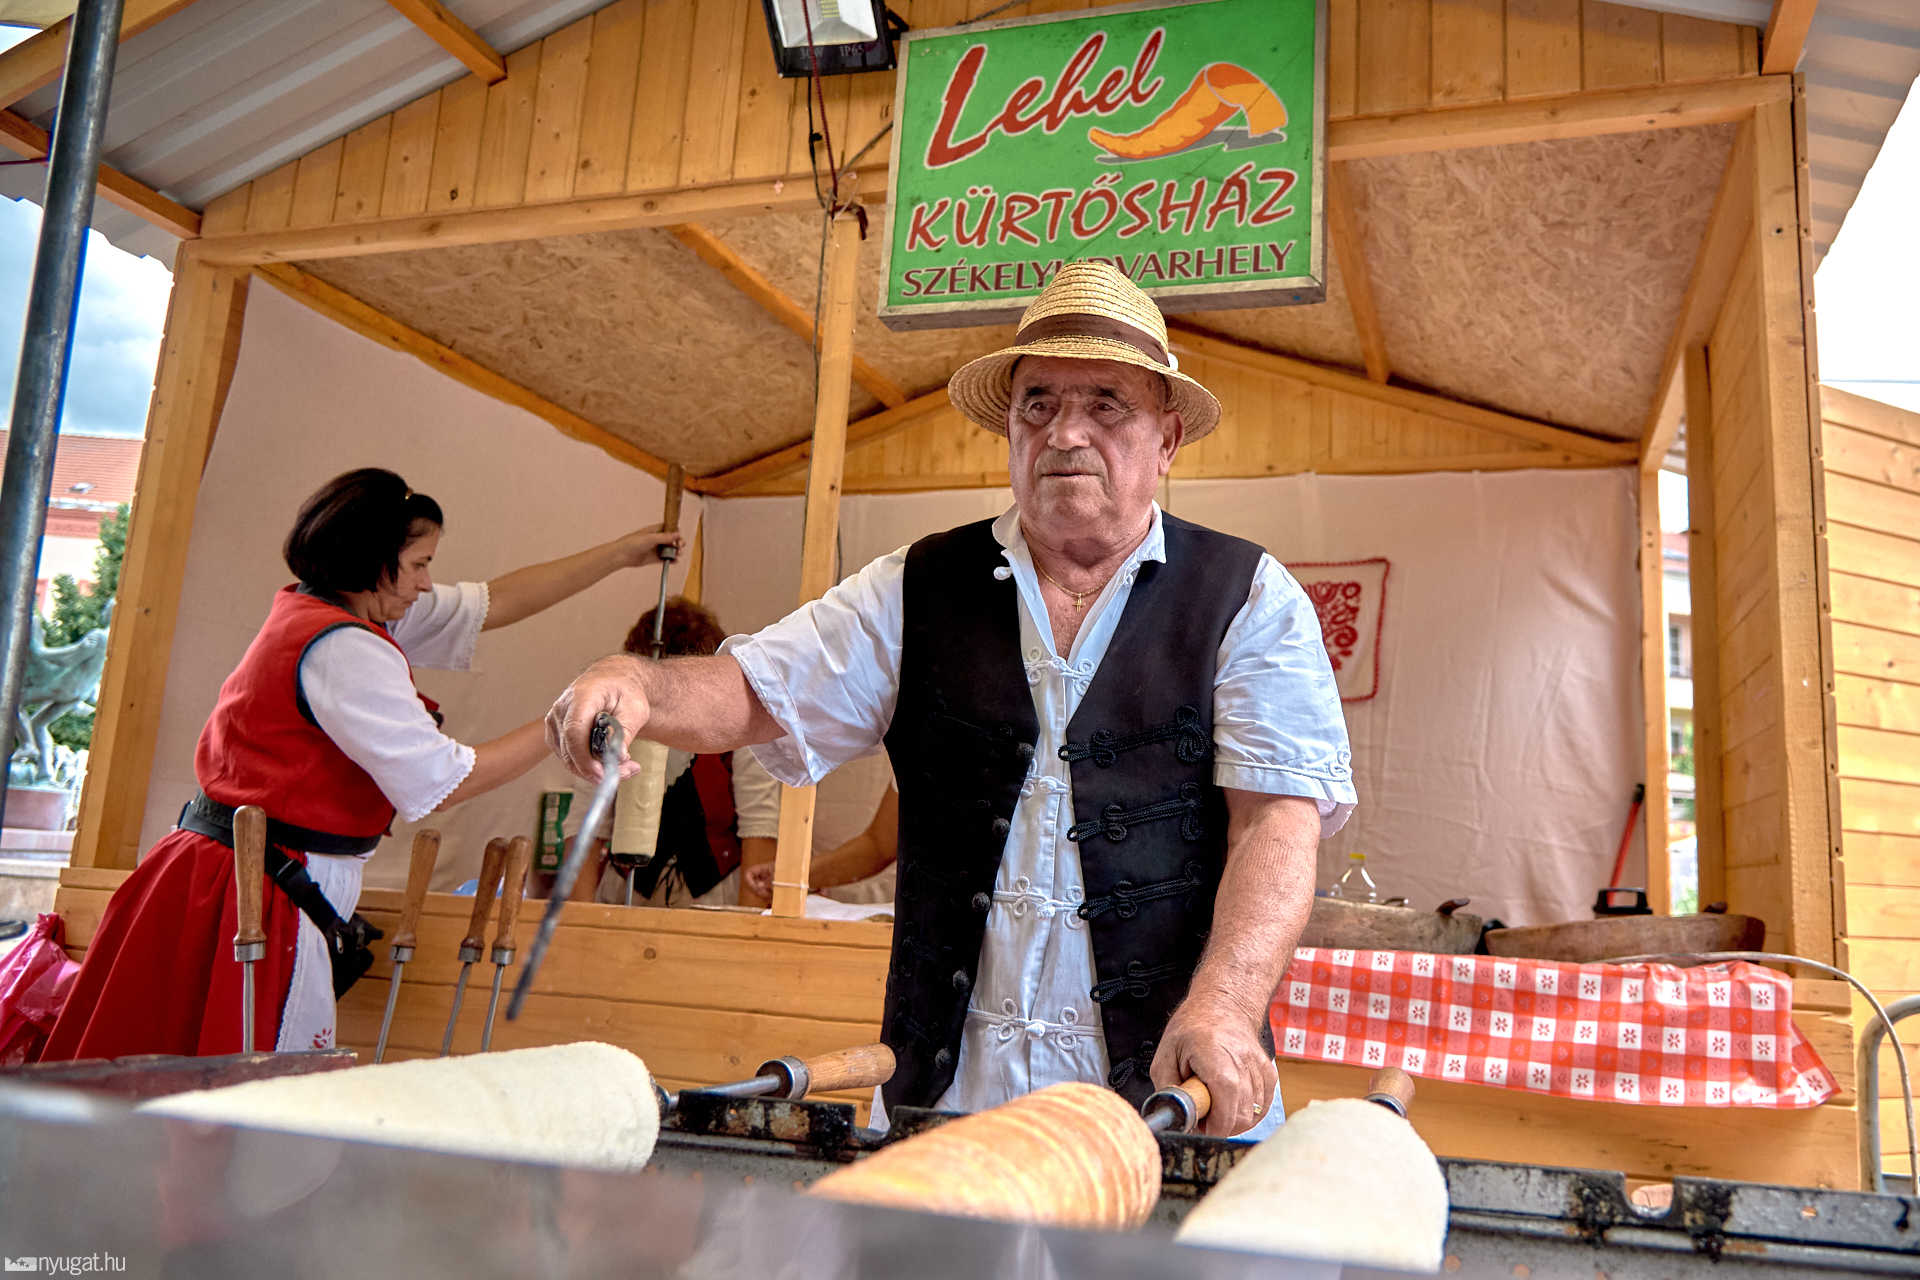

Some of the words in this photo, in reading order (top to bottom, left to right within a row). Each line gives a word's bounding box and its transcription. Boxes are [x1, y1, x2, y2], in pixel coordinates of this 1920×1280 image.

[926, 27, 1164, 169] Lehel
[906, 163, 1298, 251] KÜRTŐSHÁZ
[901, 241, 1296, 297] SZÉKELYVARHELY
